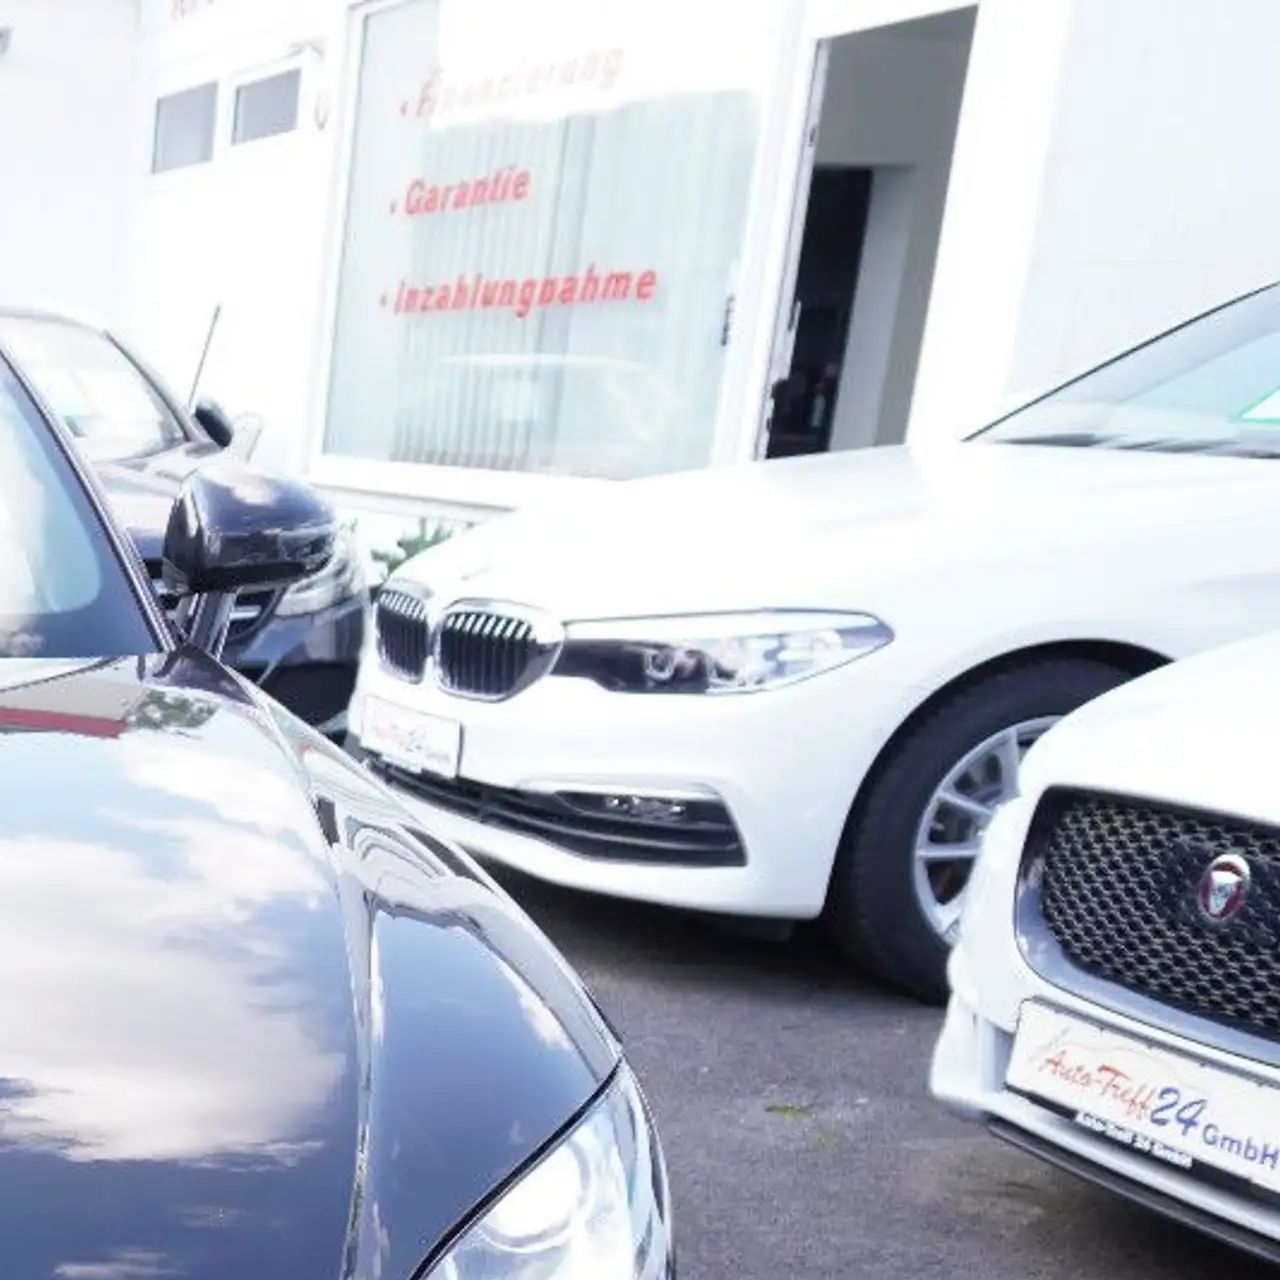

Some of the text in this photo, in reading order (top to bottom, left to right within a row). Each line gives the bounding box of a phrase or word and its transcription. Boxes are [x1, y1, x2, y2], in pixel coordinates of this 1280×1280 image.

[405, 165, 531, 214] Garantie
[394, 263, 657, 318] Inzahlungnahme
[1202, 1122, 1280, 1170] GmbH
